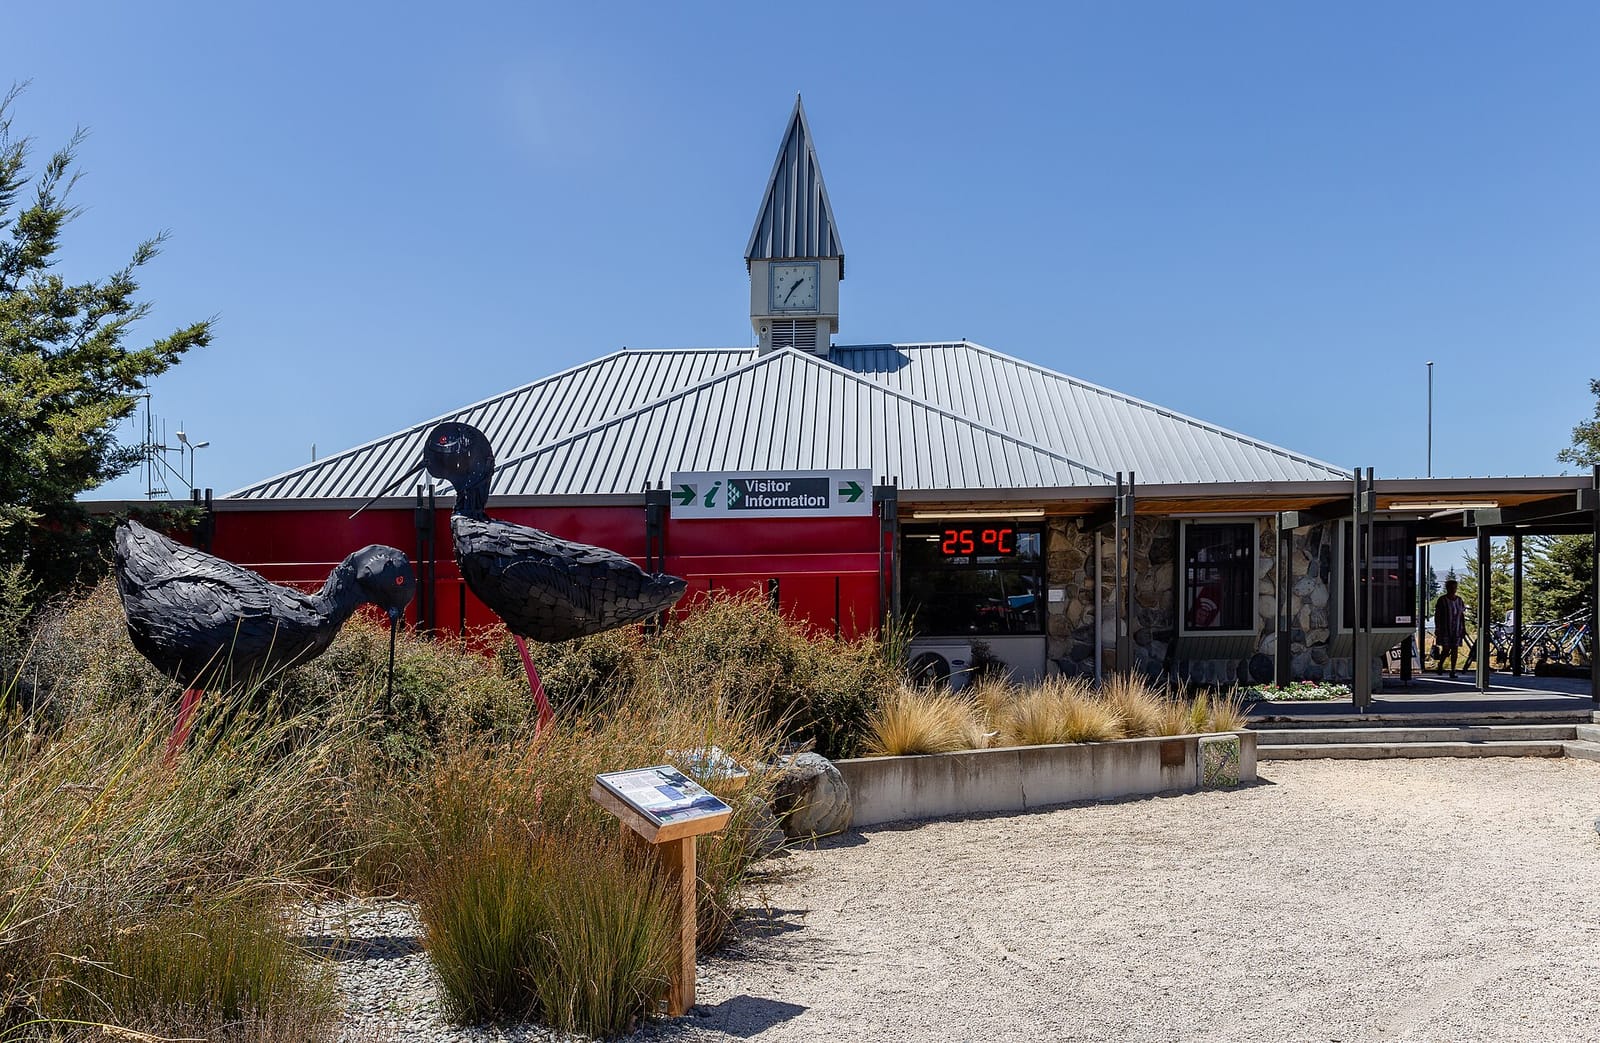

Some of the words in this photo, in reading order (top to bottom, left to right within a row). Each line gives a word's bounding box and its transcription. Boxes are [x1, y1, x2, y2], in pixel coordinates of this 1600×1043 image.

[744, 480, 791, 493] Visitor
[744, 494, 826, 508] Information
[942, 529, 975, 554] 25
